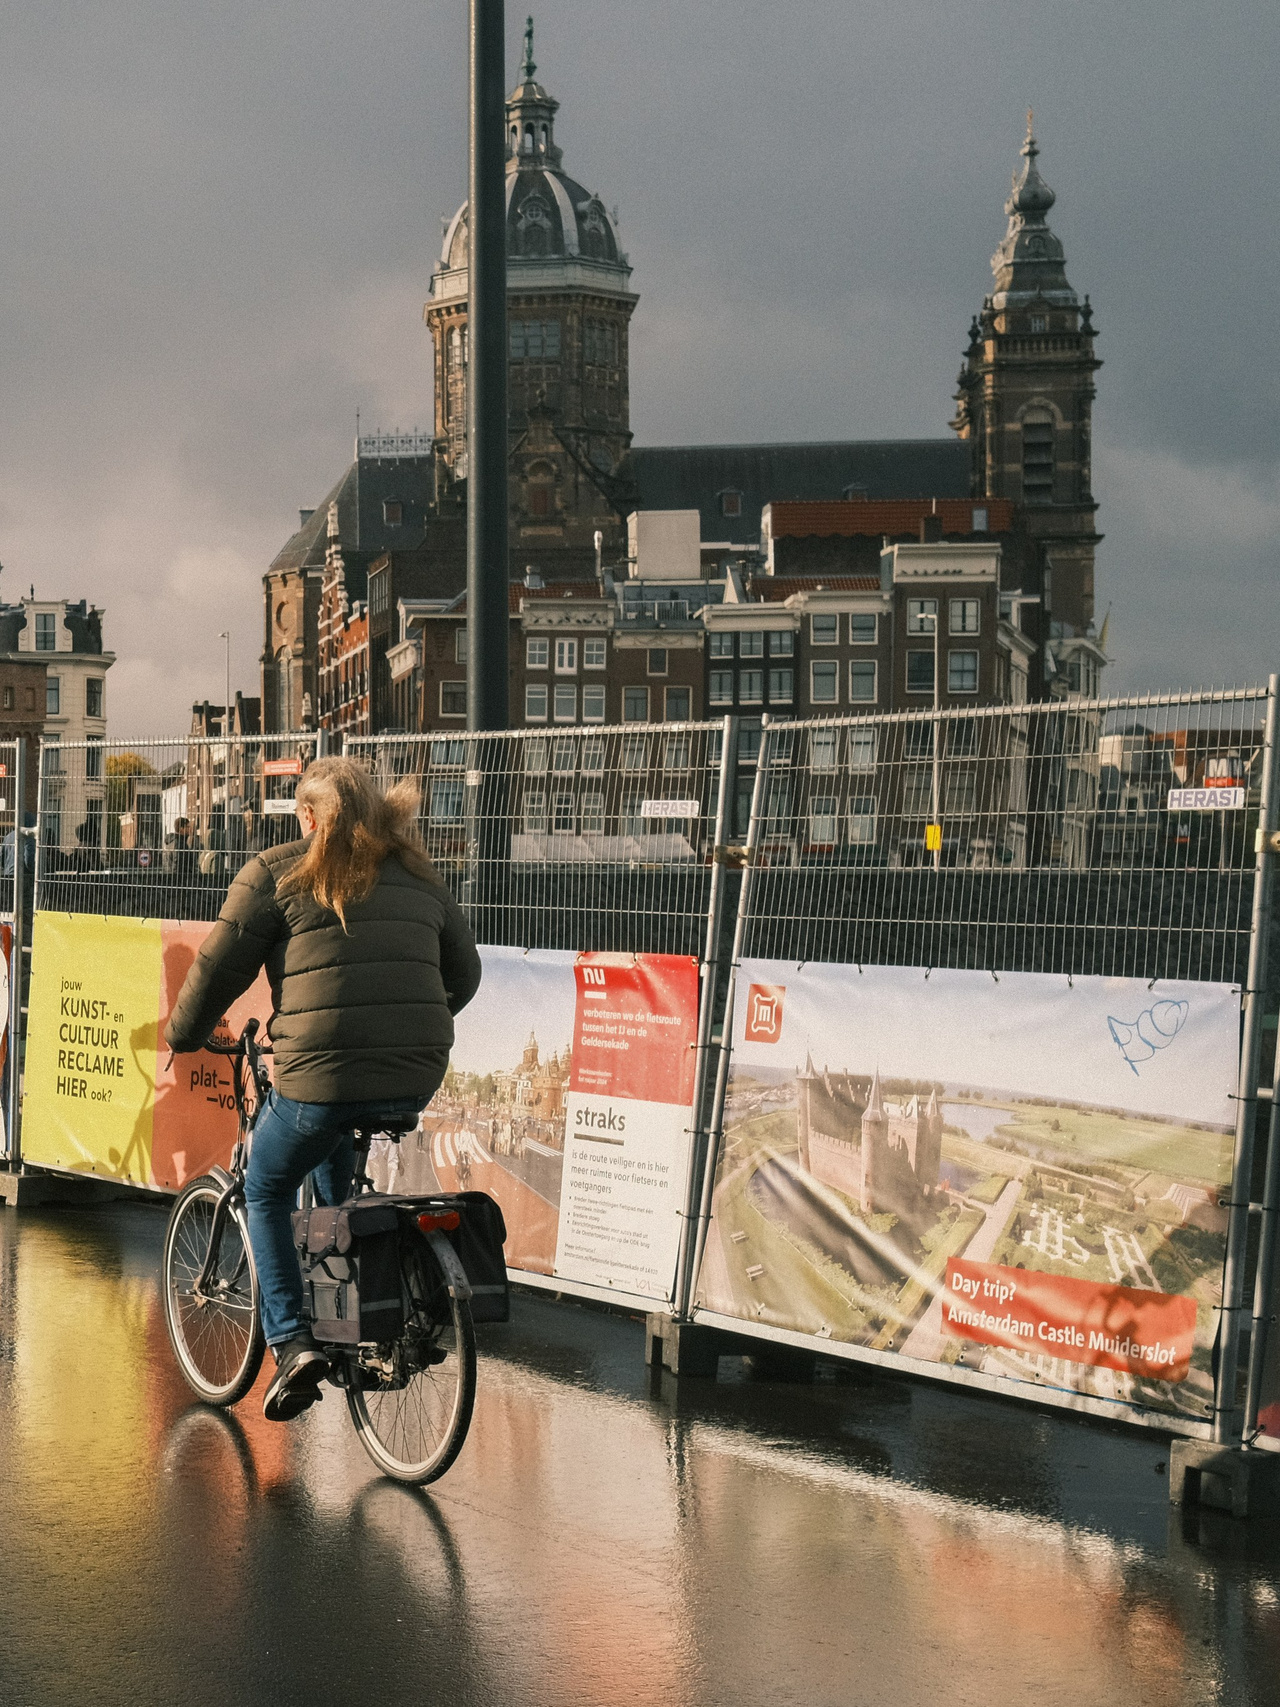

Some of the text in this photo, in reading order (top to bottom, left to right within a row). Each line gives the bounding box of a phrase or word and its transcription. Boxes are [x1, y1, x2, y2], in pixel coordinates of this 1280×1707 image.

[60, 977, 82, 992] jouw
[583, 967, 606, 985] nu
[60, 996, 124, 1023] KUNST- en
[584, 1008, 682, 1025] verbeteren we de fietsroute
[59, 1023, 118, 1050] CULTUUR
[582, 1022, 604, 1032] tussen
[606, 1023, 618, 1034] het
[626, 1028, 636, 1036] en
[638, 1027, 648, 1037] de
[582, 1036, 630, 1050] Geldersekade
[58, 1050, 124, 1078] RECLAME
[56, 1076, 112, 1102] HIER ook?
[576, 1106, 626, 1132] straks
[572, 1150, 669, 1174] is de route veiliger en is hier
[570, 1180, 612, 1194] voetgangers
[571, 1166, 668, 1188] meer ruimte voor fietsers en
[952, 1272, 1017, 1304] Day trip?
[948, 1306, 1176, 1366] Amsterdam Castle Muiderslot
